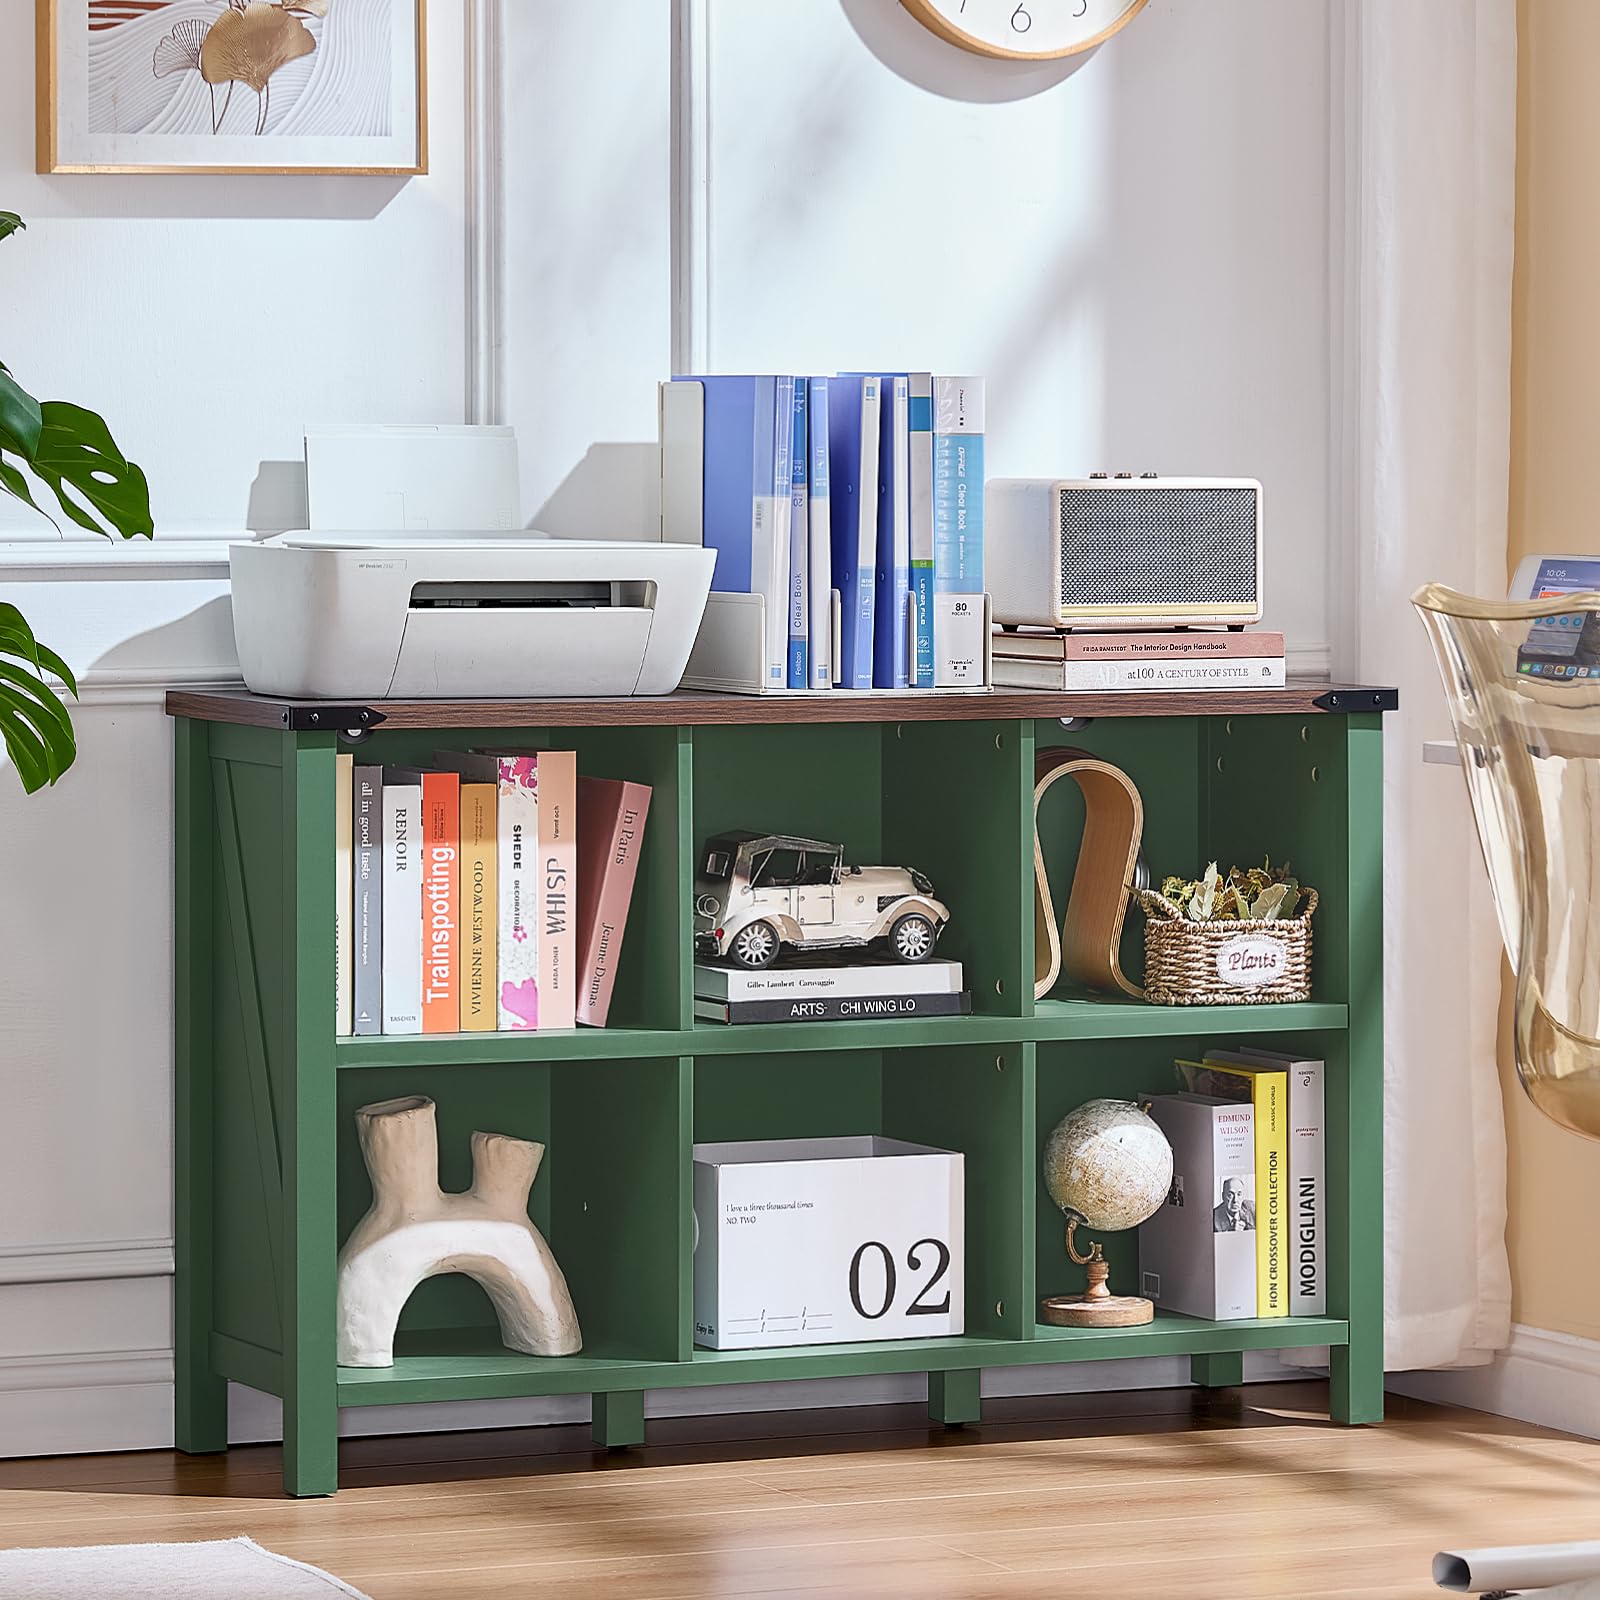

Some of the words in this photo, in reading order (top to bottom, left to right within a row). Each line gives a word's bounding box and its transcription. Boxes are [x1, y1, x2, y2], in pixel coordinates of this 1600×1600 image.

[1010, 2, 1032, 33] 6
[957, 483, 967, 507] Clear
[957, 509, 967, 531] Book
[794, 572, 802, 598] Book
[1546, 569, 1567, 577] 10:05
[793, 600, 802, 628] Clear
[955, 602, 967, 612] 80
[1130, 644, 1143, 652] The
[1144, 643, 1169, 651] Interior
[1169, 643, 1192, 652] Design
[1193, 642, 1227, 650] Handbook
[1157, 670, 1164, 679] A
[1165, 669, 1208, 679] CENTURY
[1208, 668, 1222, 677] OF
[1222, 667, 1249, 677] STYLE
[361, 781, 373, 796] all
[361, 800, 373, 813] in
[622, 808, 639, 825] In
[358, 816, 373, 848] good
[395, 807, 407, 872] RENOIR
[513, 824, 522, 869] SHEDE
[615, 828, 635, 865] Paris
[360, 851, 371, 880] taste
[472, 861, 484, 945] WESTWOOD
[545, 857, 567, 935] WHISP
[597, 922, 615, 964] Jeanne
[1228, 949, 1277, 971] Plants
[471, 947, 482, 1015] VIVIENNE
[588, 966, 607, 1007] Damas
[746, 981, 765, 989] Gilles
[767, 980, 795, 988] Lambert
[798, 978, 835, 987] Caravaggio
[840, 1001, 861, 1014] CHI
[863, 1000, 898, 1014] WING
[899, 998, 916, 1012] LO
[1218, 1113, 1251, 1123] EDMUND
[1219, 1125, 1249, 1135] WILSON
[1269, 1151, 1278, 1214] COLLECTION
[730, 1203, 742, 1212] love
[749, 1202, 765, 1212] three
[766, 1200, 796, 1211] thousand
[797, 1201, 814, 1209] times
[739, 1215, 757, 1224] TWO
[1269, 1218, 1278, 1280] CROSSOVER
[1299, 1177, 1316, 1296] MODIGLIANI
[848, 1237, 951, 1320] 02
[1269, 1283, 1278, 1308] FION
